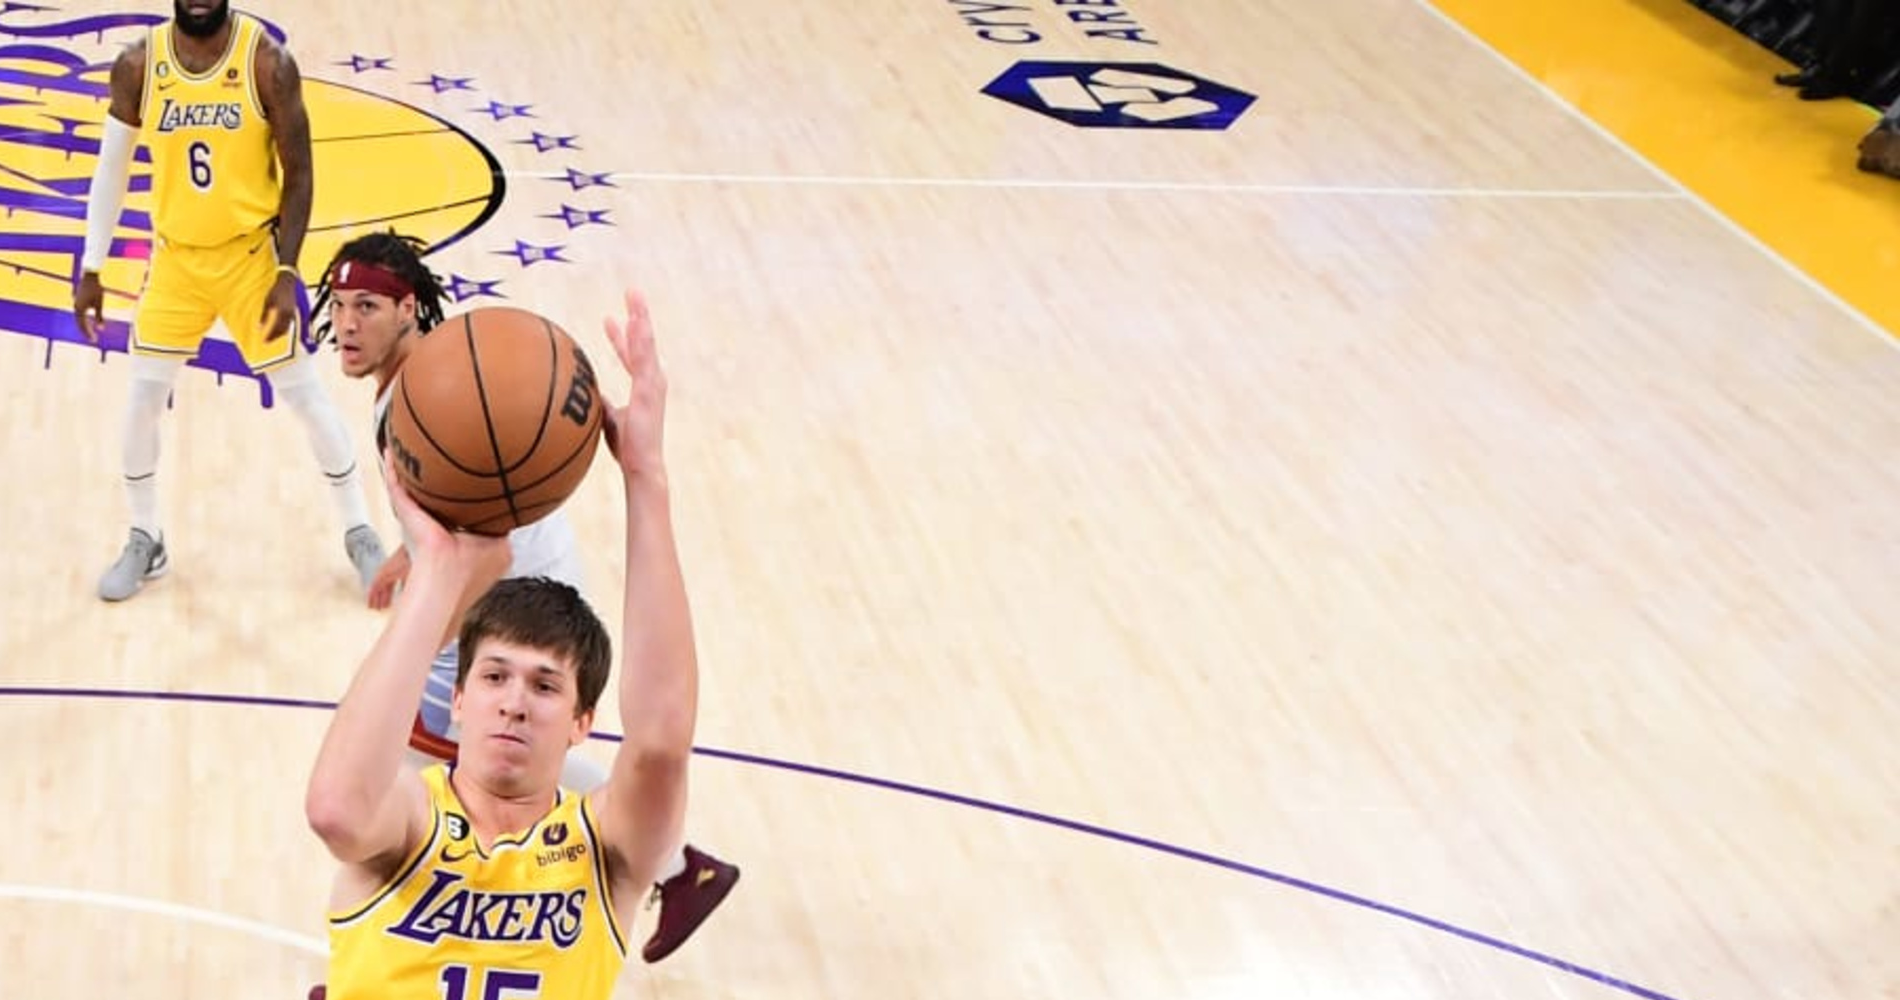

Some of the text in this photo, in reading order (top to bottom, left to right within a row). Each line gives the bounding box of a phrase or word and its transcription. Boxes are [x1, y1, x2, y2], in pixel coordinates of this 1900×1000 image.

[157, 98, 242, 132] LAKERS
[188, 140, 212, 189] 6
[536, 843, 586, 867] bibigo
[385, 868, 587, 949] LAKERS
